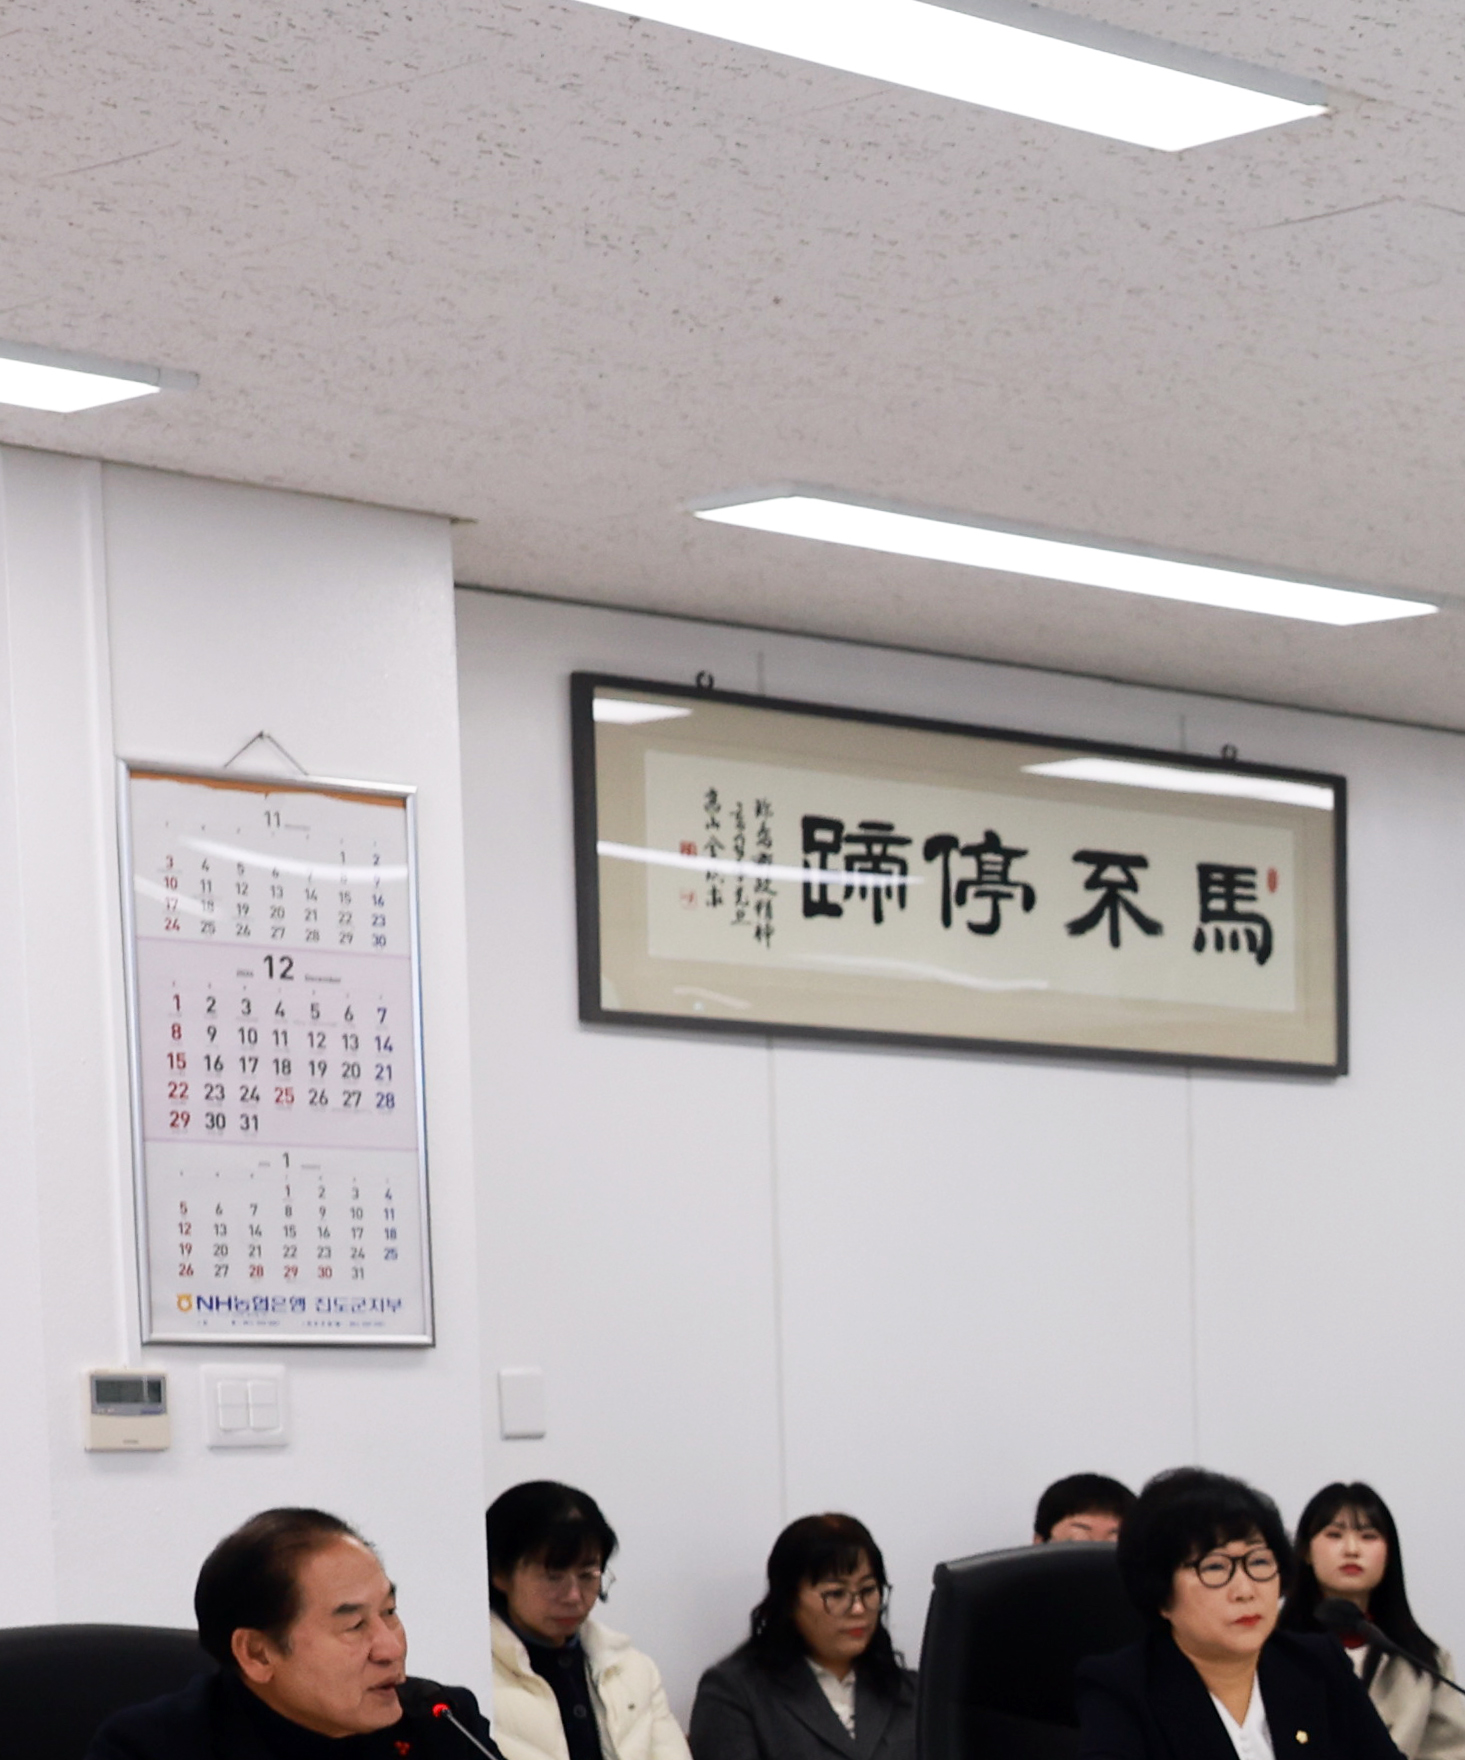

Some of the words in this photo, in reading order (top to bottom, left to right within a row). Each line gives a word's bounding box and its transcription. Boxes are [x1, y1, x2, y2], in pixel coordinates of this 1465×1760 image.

[263, 955, 295, 980] 12
[173, 994, 181, 1011] 1
[206, 996, 216, 1014] 2
[241, 998, 251, 1015] 3
[275, 1001, 285, 1018] 4
[310, 1003, 320, 1020] 5
[344, 1005, 354, 1022] 6
[377, 1008, 387, 1024] 7
[171, 1023, 182, 1040] 8
[207, 1025, 217, 1043] 9
[238, 1027, 258, 1045] 10
[272, 1029, 288, 1046] 11
[308, 1032, 326, 1049] 12
[342, 1034, 359, 1051] 13
[375, 1036, 393, 1052] 14
[167, 1052, 186, 1070] 15
[204, 1055, 224, 1072] 16
[239, 1057, 259, 1074] 17
[273, 1058, 292, 1075] 18
[309, 1060, 327, 1077] 19
[342, 1062, 361, 1079] 20
[375, 1064, 392, 1081] 21
[168, 1081, 189, 1100] 22
[204, 1084, 225, 1101] 23
[240, 1085, 260, 1103] 24
[274, 1087, 295, 1104] 25
[308, 1089, 329, 1106] 26
[342, 1091, 362, 1108] 27
[376, 1092, 395, 1109] 28
[170, 1111, 190, 1129] 29
[205, 1113, 226, 1130] 30
[240, 1114, 259, 1131] 31
[283, 1153, 290, 1168] 1
[285, 1185, 290, 1197] 1
[318, 1186, 325, 1199] 2
[352, 1188, 359, 1200] 3
[385, 1189, 392, 1200] 4
[180, 1202, 187, 1214] 5
[216, 1203, 223, 1215] 6
[251, 1204, 257, 1217] 7
[285, 1205, 292, 1217] 8
[319, 1207, 326, 1219] 9
[351, 1207, 363, 1220] 10
[385, 1208, 394, 1221] 11
[179, 1222, 191, 1235] 12
[214, 1224, 227, 1237] 13
[249, 1224, 262, 1237] 14
[284, 1225, 296, 1238] 15
[318, 1226, 330, 1238] 16
[351, 1227, 364, 1239] 17
[385, 1228, 397, 1240] 18
[179, 1243, 192, 1256] 19
[213, 1245, 228, 1257] 20
[248, 1245, 262, 1258] 21
[283, 1246, 297, 1259] 22
[317, 1247, 331, 1259] 23
[351, 1248, 365, 1260] 24
[384, 1248, 398, 1261] 25
[179, 1263, 194, 1277] 26
[214, 1264, 229, 1278] 27
[249, 1265, 264, 1278] 28
[284, 1266, 298, 1279] 29
[318, 1266, 332, 1279] 30
[351, 1267, 364, 1280] 31
